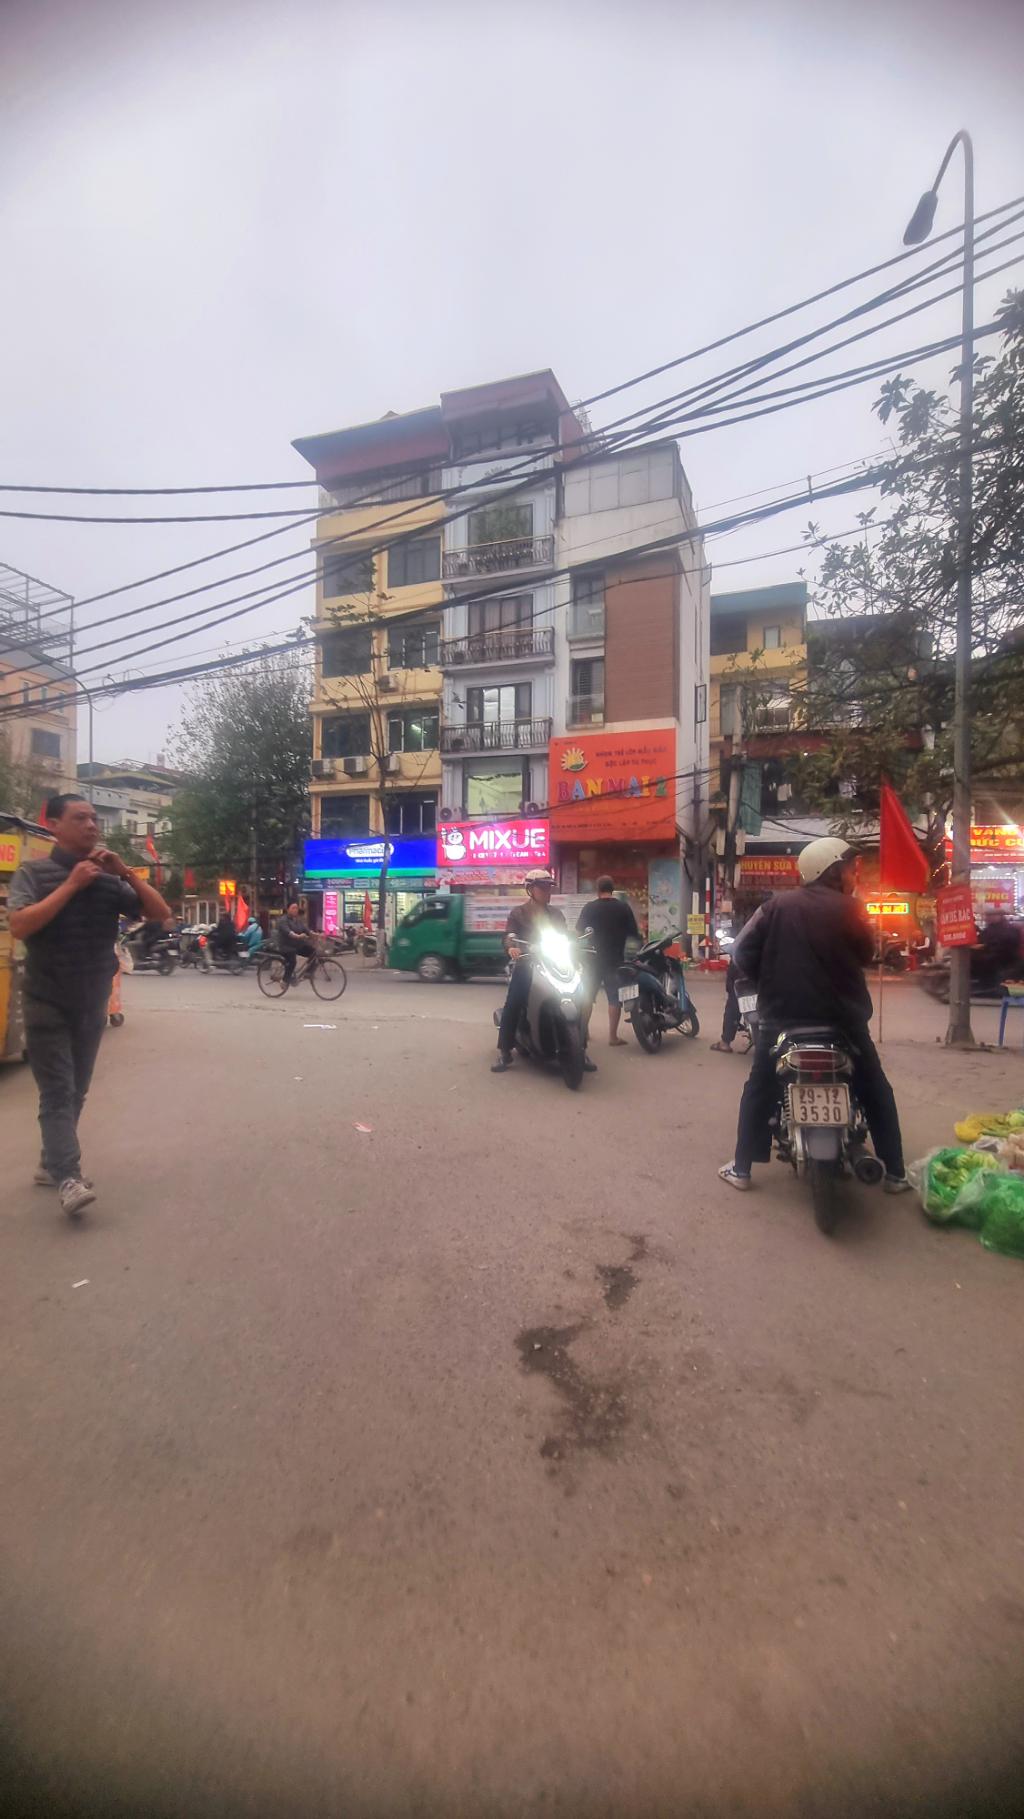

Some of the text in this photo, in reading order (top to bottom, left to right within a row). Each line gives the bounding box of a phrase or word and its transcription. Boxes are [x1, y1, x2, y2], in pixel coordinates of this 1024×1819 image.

[558, 778, 602, 801] BAN
[607, 775, 650, 798] MAI
[469, 828, 545, 850] MIXUE
[800, 1105, 841, 1122] 3530
